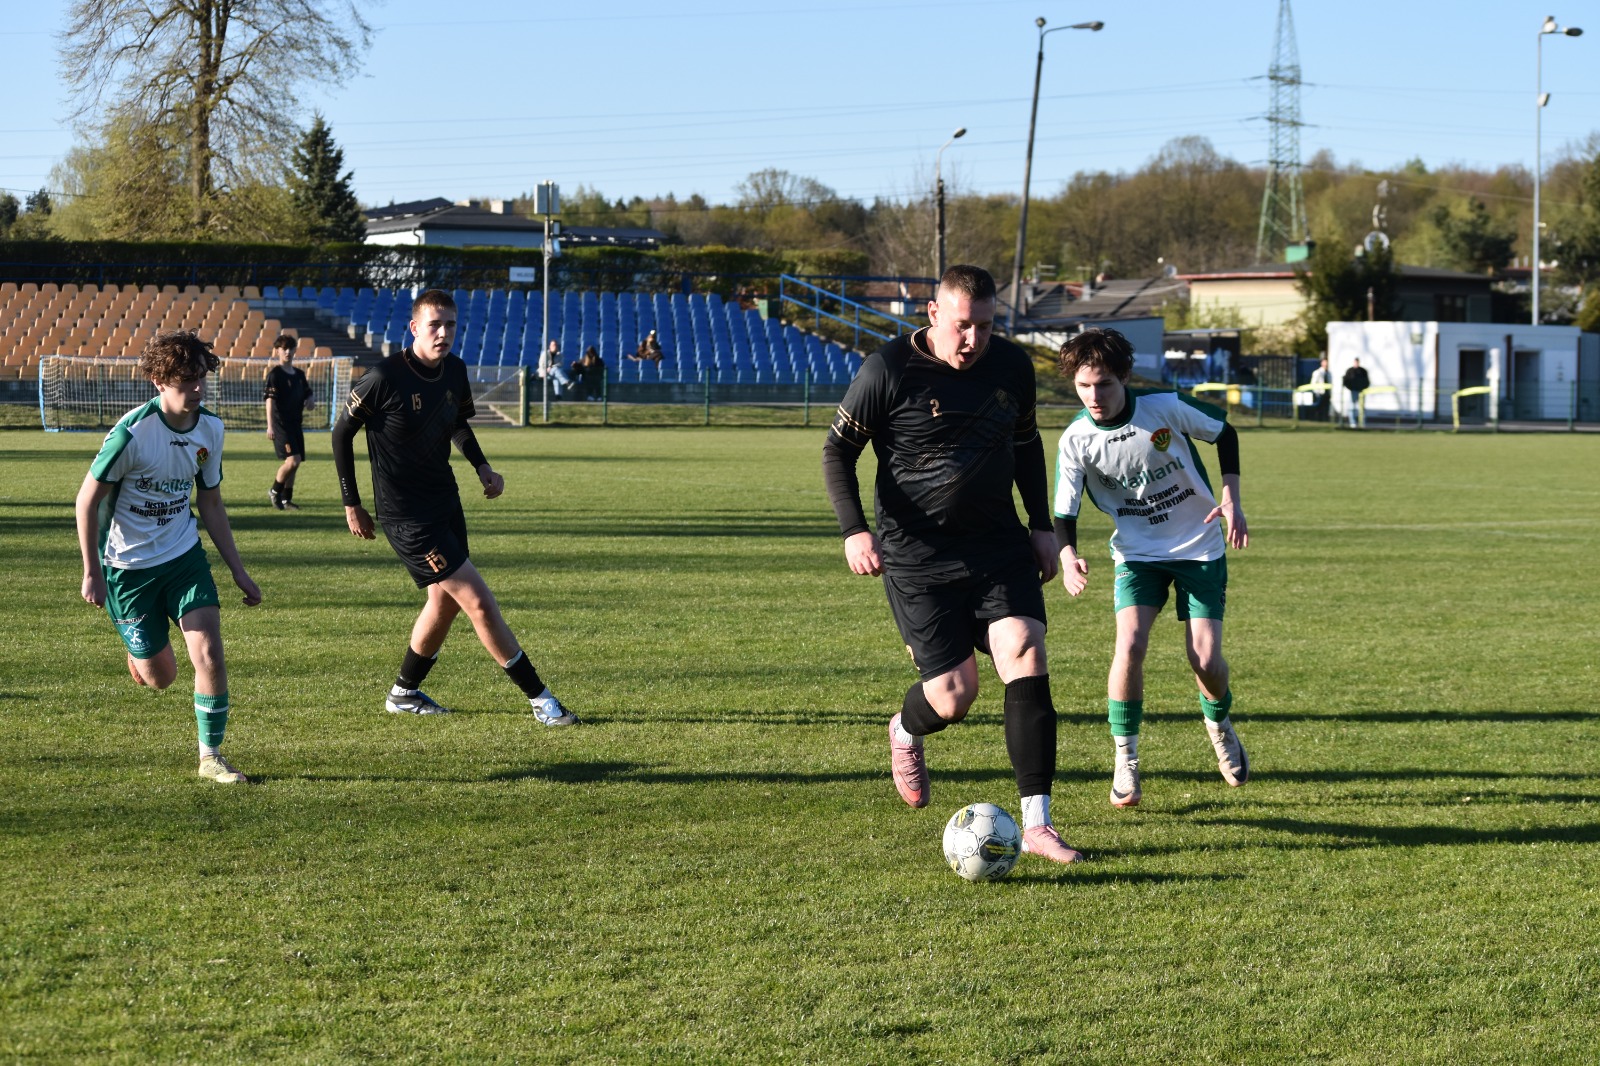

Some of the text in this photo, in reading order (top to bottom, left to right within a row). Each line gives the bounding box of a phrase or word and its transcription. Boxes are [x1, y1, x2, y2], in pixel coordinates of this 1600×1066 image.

[411, 393, 422, 411] 15
[1107, 431, 1136, 444] regio
[1124, 484, 1180, 507] INSTAL SERWIS
[1154, 487, 1197, 511] STRYJNIAK
